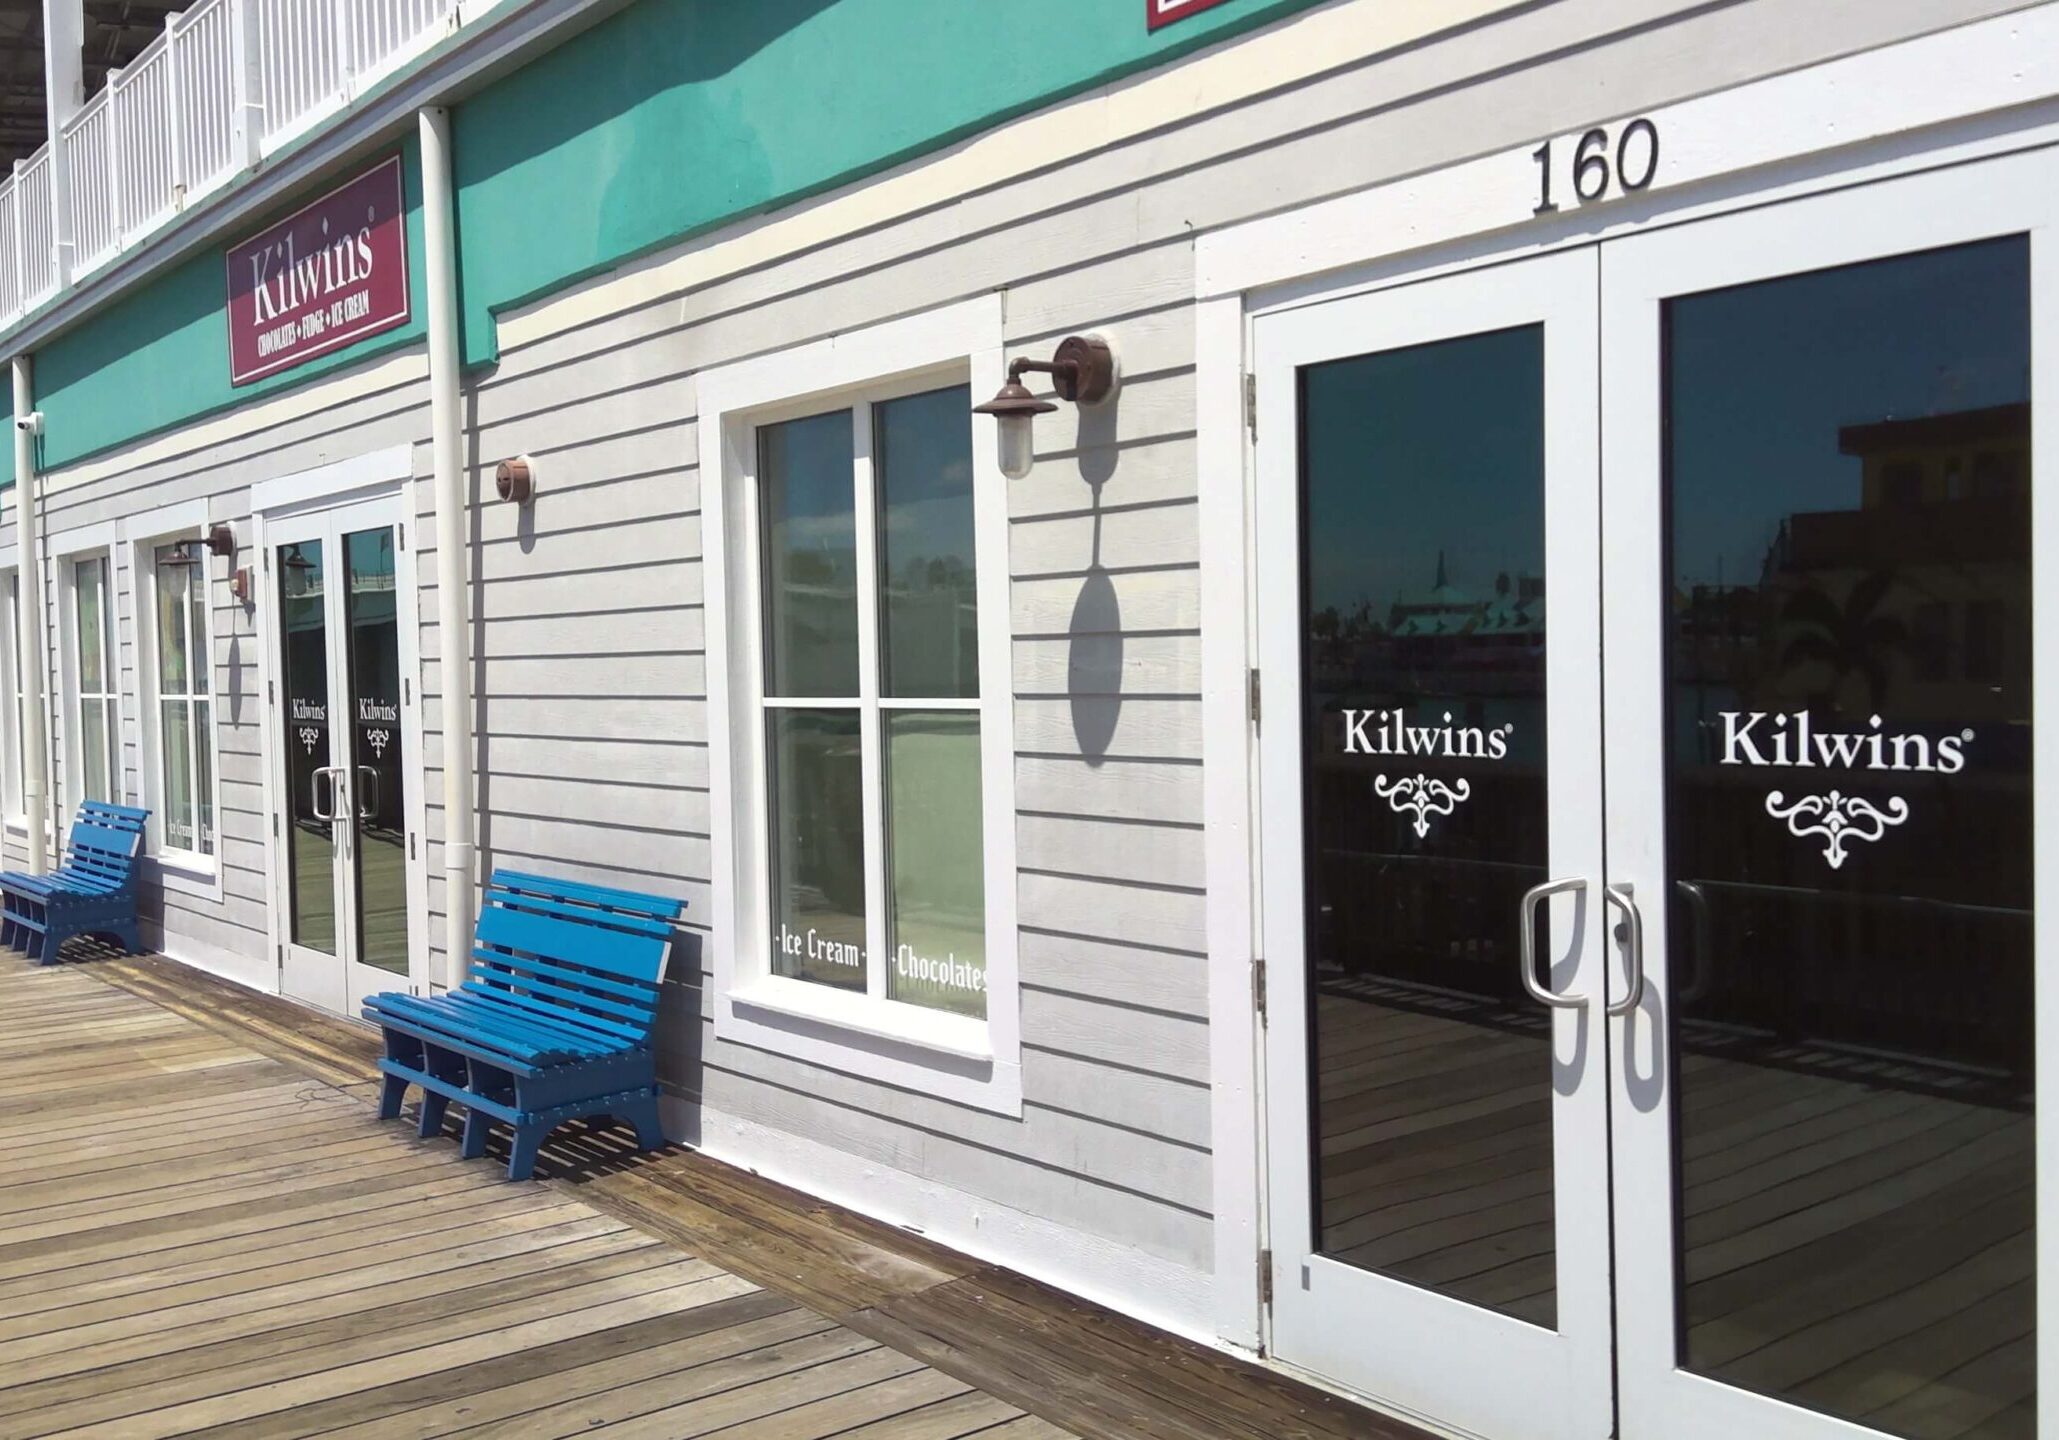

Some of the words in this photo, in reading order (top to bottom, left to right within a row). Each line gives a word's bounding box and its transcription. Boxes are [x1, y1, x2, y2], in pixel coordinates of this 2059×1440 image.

[1532, 118, 1659, 215] 160
[250, 217, 373, 326] Kilwins
[258, 322, 297, 358] CHOCOLATES
[301, 311, 325, 340] FUDGE
[331, 301, 343, 329] ICE
[344, 289, 370, 323] CREAM
[292, 698, 325, 720] Kilwins
[359, 698, 397, 721] Kilwins
[1342, 709, 1507, 760] Kilwins
[1719, 711, 1966, 774] Kilwins
